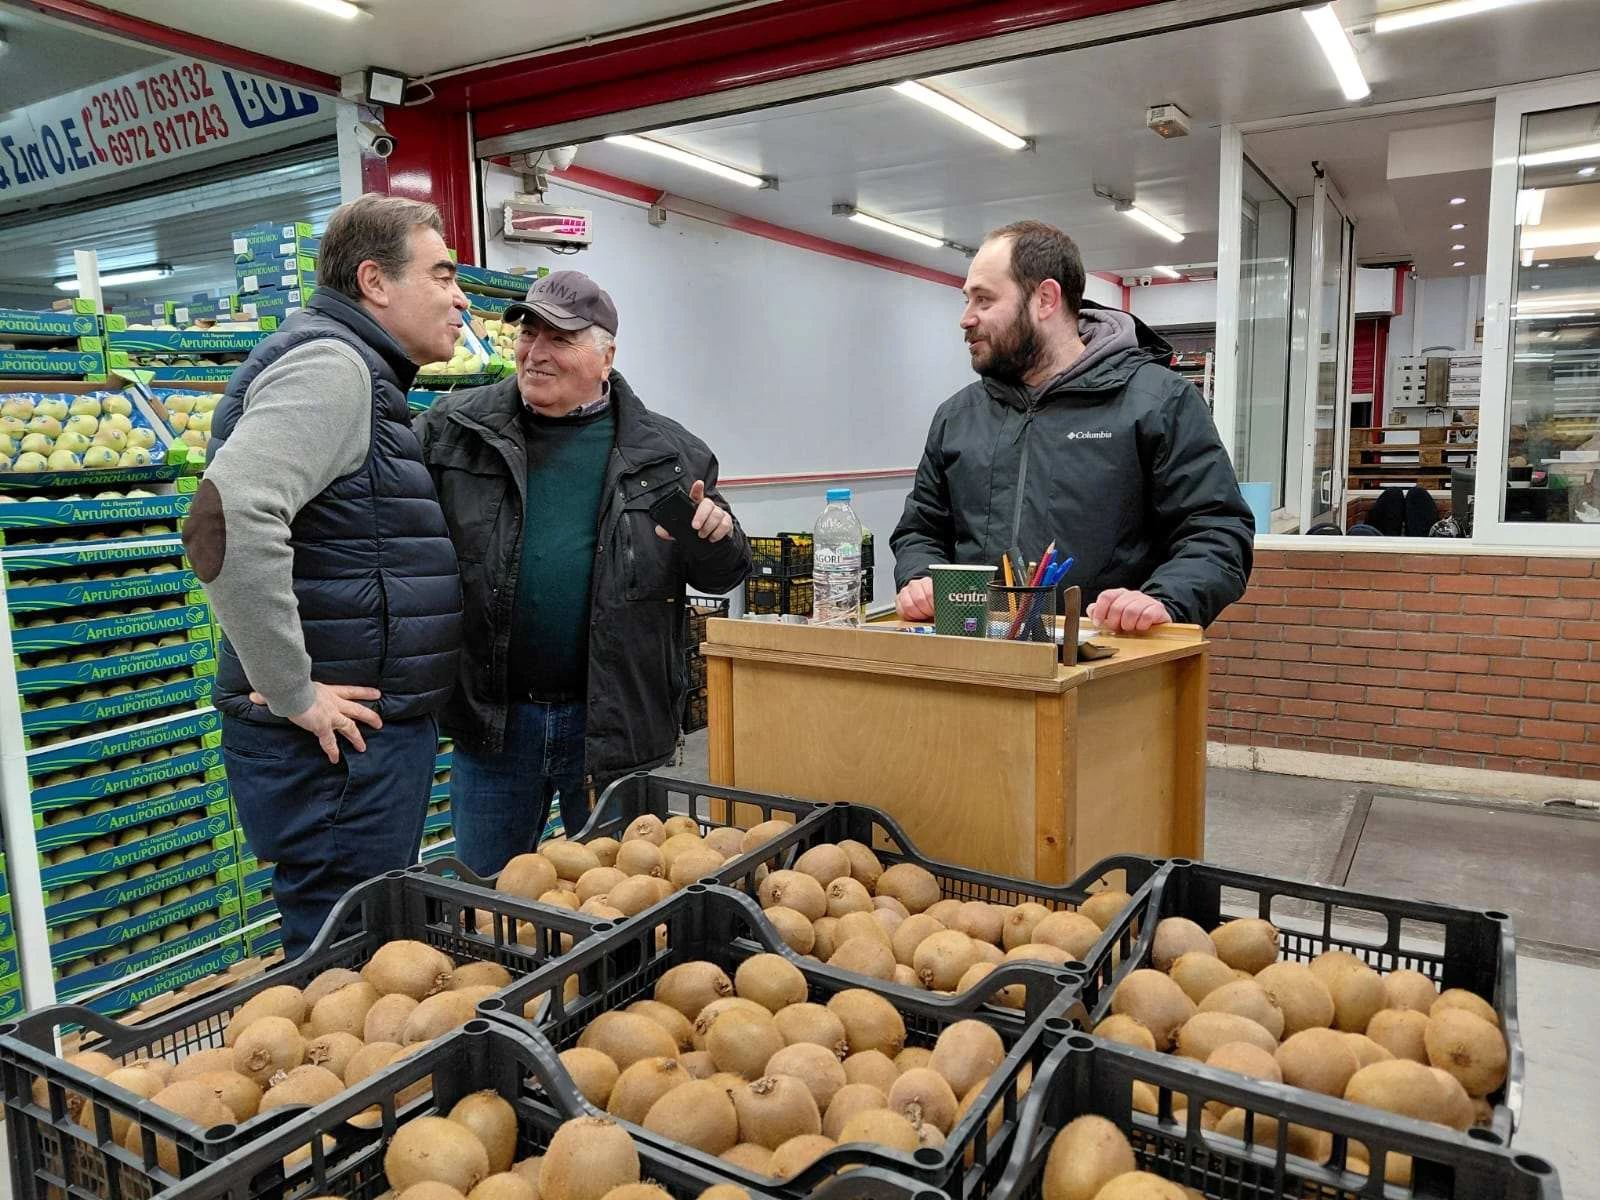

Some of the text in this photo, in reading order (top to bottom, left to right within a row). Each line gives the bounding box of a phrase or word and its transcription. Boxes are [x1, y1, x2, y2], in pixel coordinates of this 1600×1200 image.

[92, 63, 214, 128] 2310 763132
[108, 103, 229, 166] 6972 817243
[1076, 431, 1112, 439] Columbia
